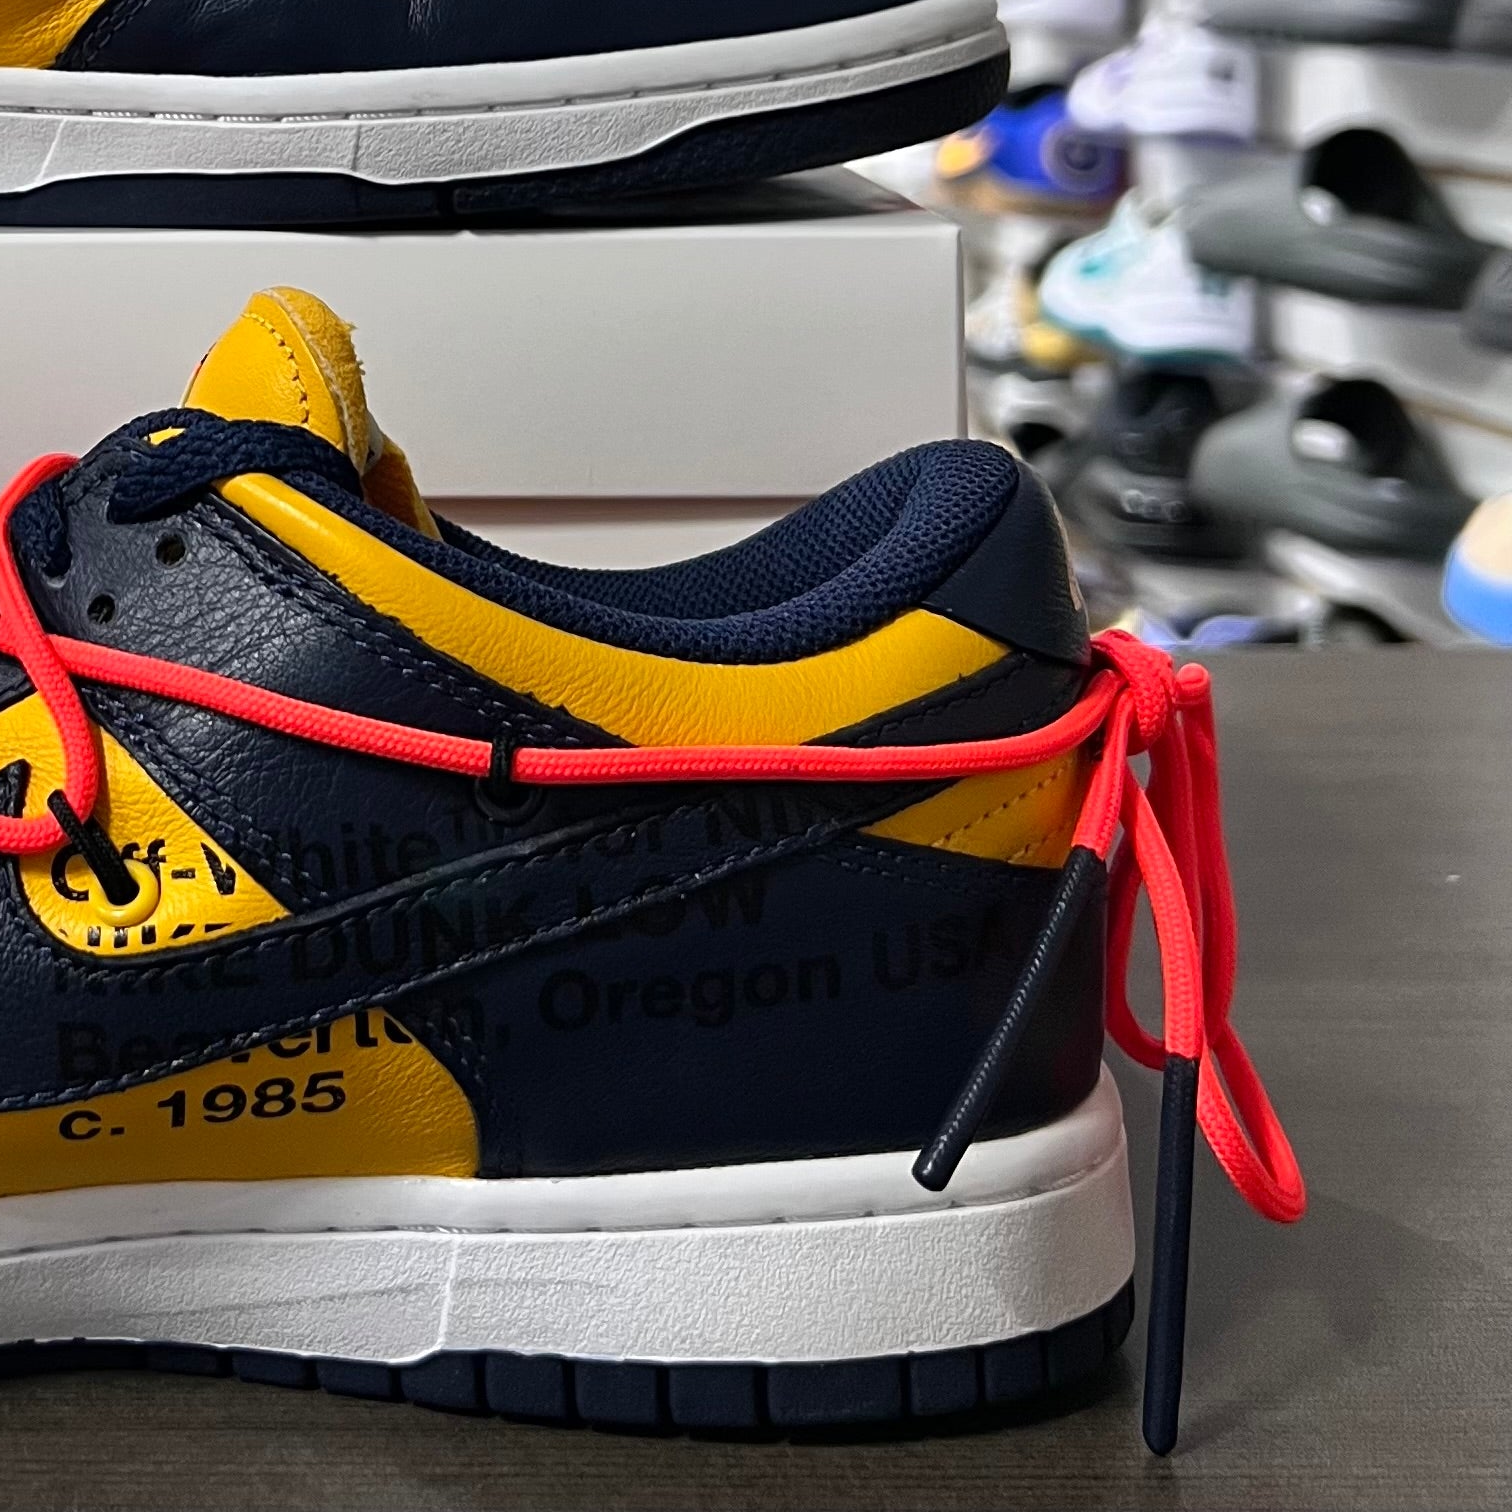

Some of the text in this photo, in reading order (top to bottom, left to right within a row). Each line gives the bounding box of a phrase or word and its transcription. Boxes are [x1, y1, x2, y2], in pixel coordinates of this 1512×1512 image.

[538, 953, 841, 1031] Oregon
[58, 1071, 347, 1141] c. 1985
